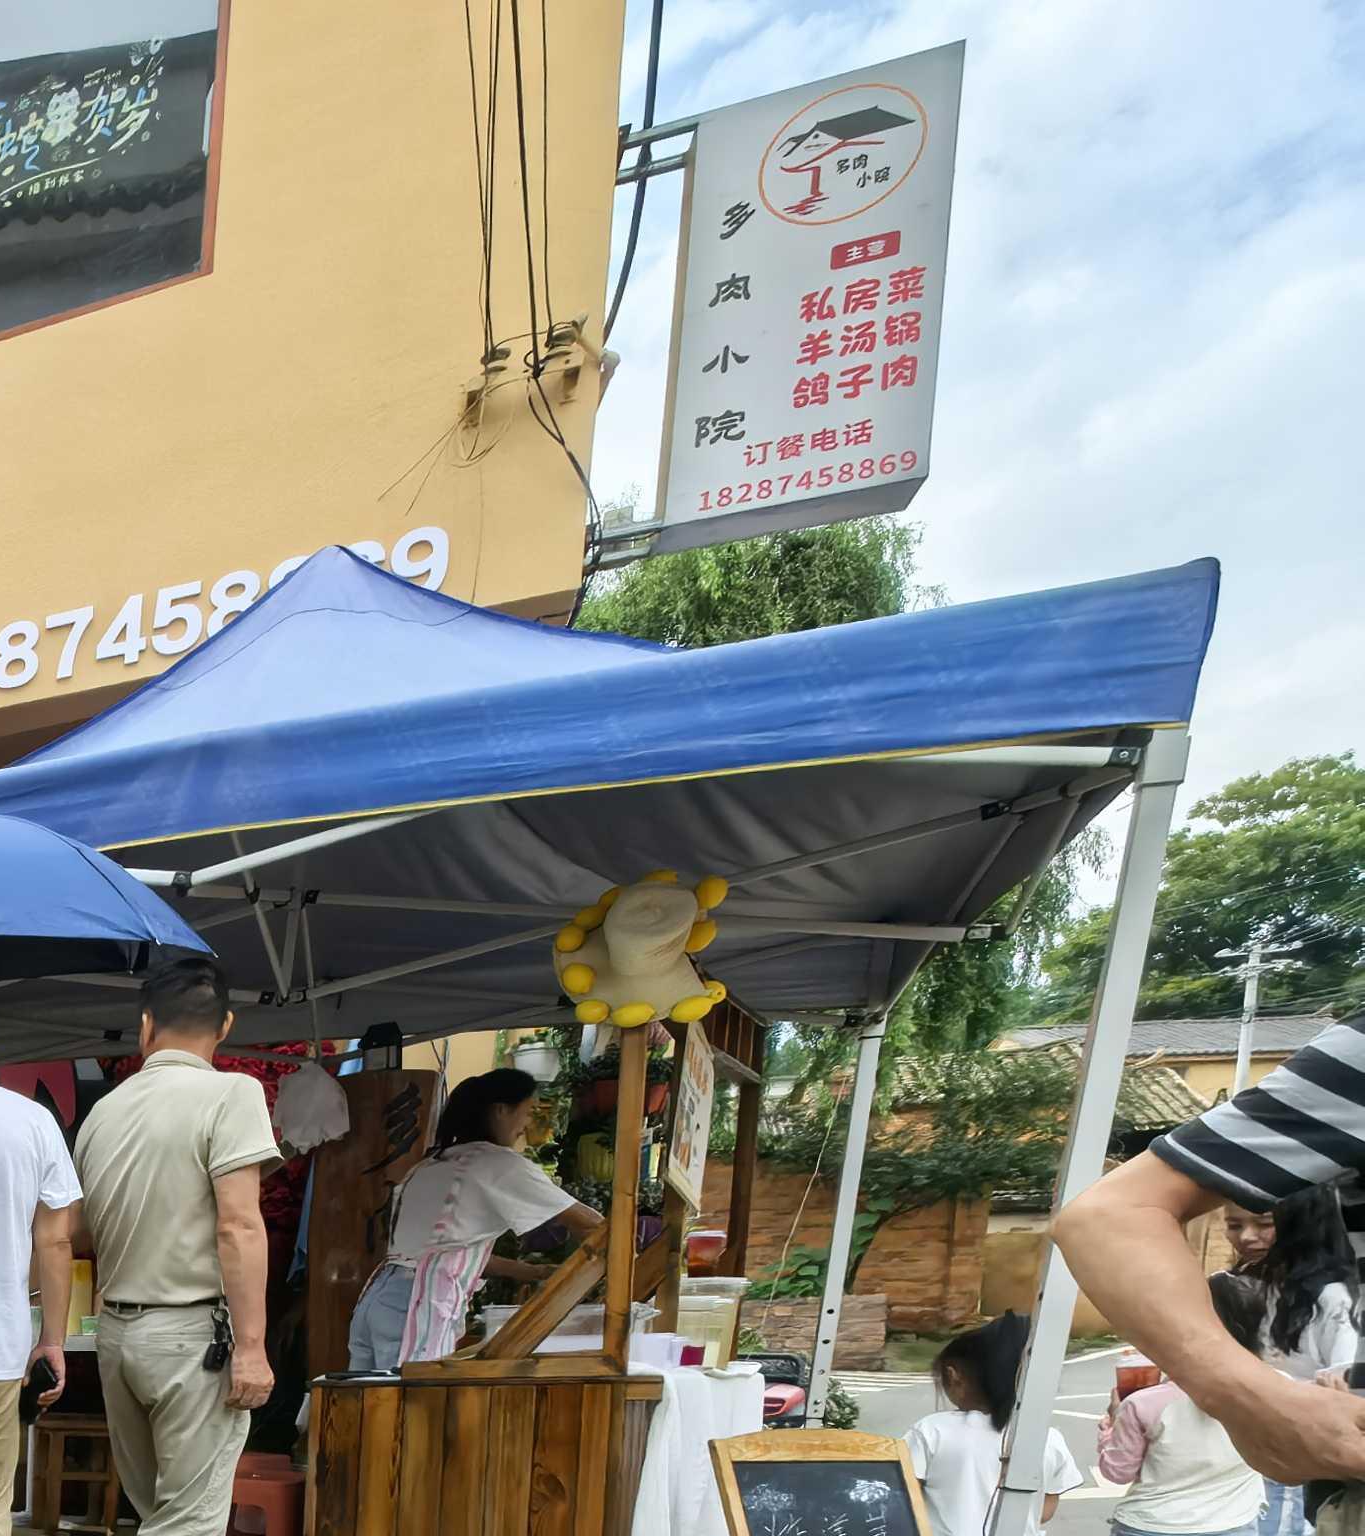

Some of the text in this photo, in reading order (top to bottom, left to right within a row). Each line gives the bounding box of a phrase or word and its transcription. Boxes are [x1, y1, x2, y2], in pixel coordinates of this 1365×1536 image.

[836, 153, 869, 175] 多肉
[799, 266, 927, 323] 私房菜
[695, 200, 756, 448] 多肉小院
[796, 311, 922, 366] 羊汤锅
[792, 354, 918, 409] 鸽子肉
[743, 418, 875, 468] 订餐电话
[698, 449, 918, 512] 18287458869
